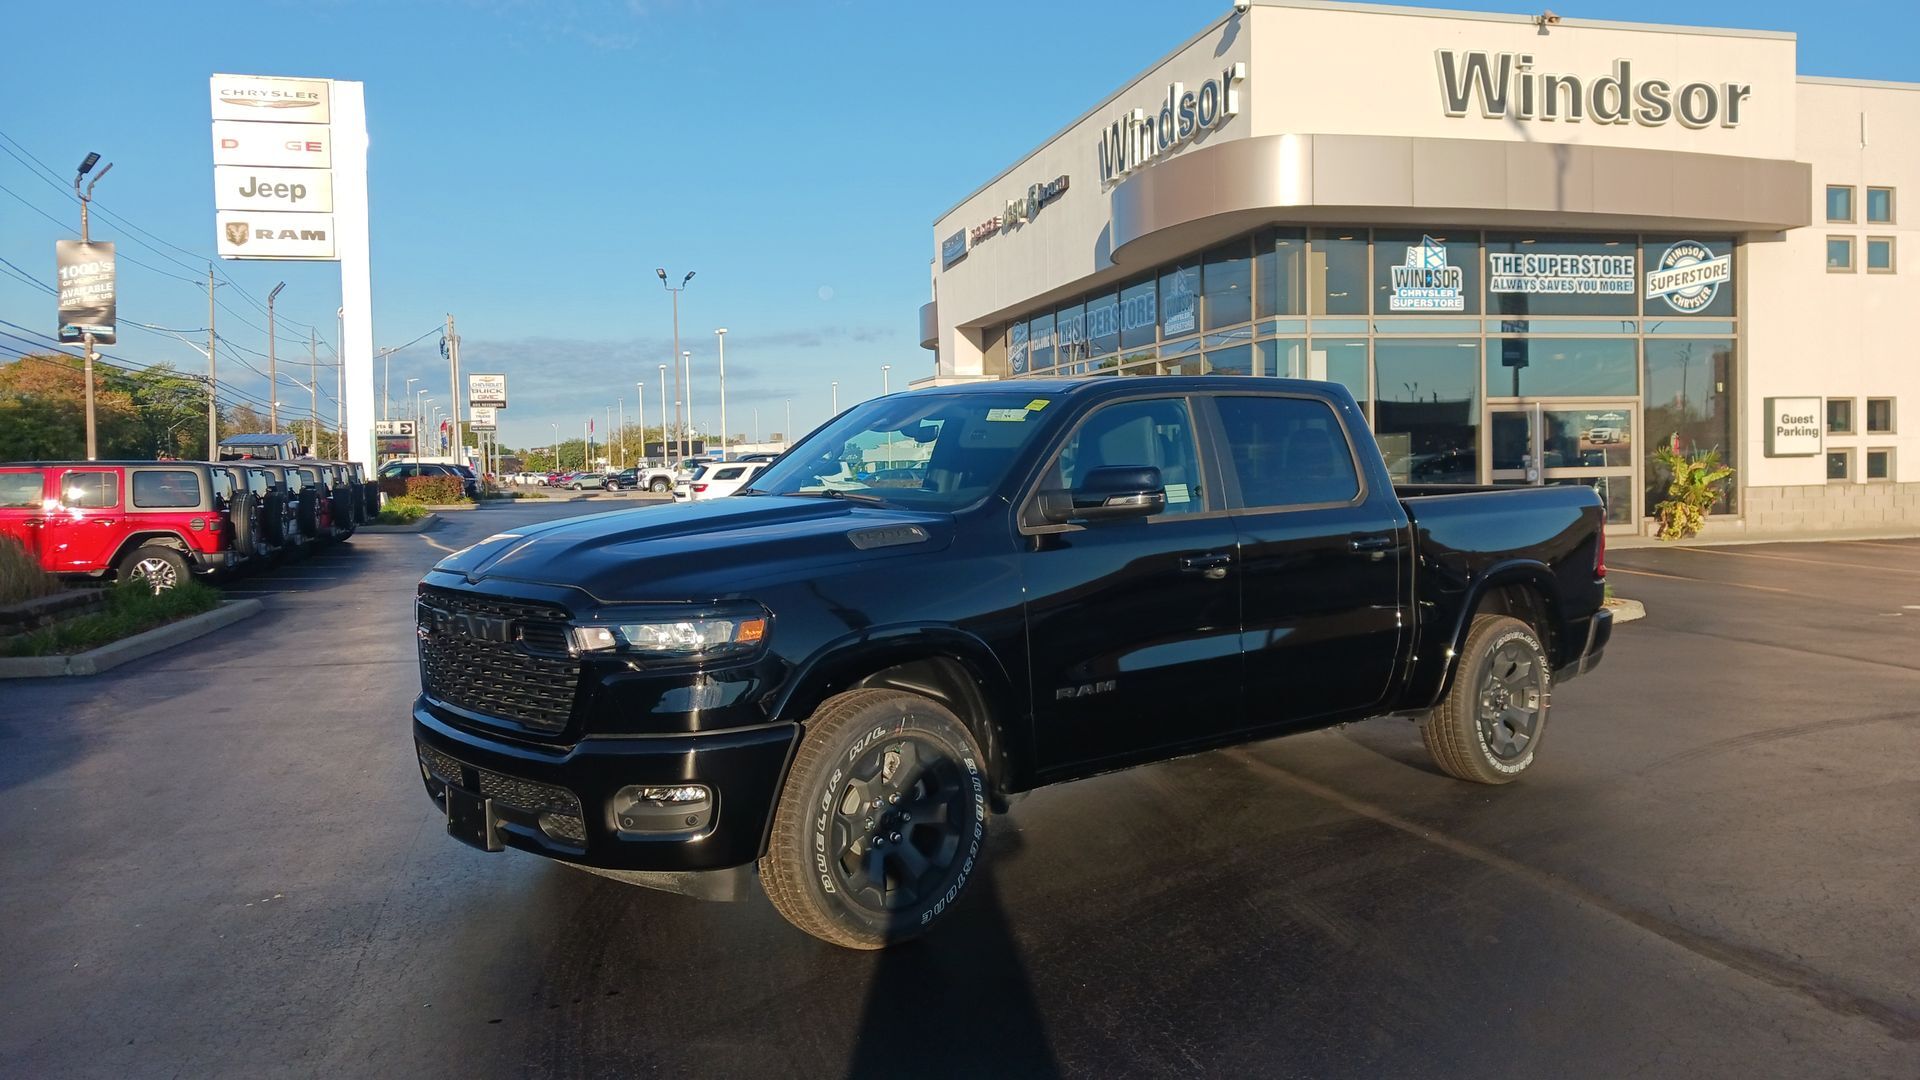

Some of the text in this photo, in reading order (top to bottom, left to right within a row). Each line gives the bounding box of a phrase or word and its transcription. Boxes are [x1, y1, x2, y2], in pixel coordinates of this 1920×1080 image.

[221, 89, 319, 100] CHRYSLER
[1434, 48, 1750, 129] Windsor
[1100, 62, 1246, 182] Windsor
[221, 138, 322, 153] DGE
[239, 176, 307, 203] Jeep
[255, 229, 326, 241] RAM
[1493, 255, 1633, 276] THE SUPERSTORE
[1665, 246, 1705, 266] WINDSOR
[1394, 268, 1460, 289] WINDSOR
[1492, 279, 1633, 292] ALWAYS SAVES YOU MORE!
[1650, 263, 1727, 292] SUPERSTORE
[1393, 298, 1461, 307] SUPERSTORE
[1673, 286, 1713, 308] CHRYSLER
[1073, 292, 1155, 343] SUPERSTORE
[1781, 413, 1814, 424] Guest
[1776, 426, 1819, 438] Parking
[433, 607, 510, 642] RAM
[1056, 680, 1116, 700] RAM
[814, 767, 842, 894] DUELER
[920, 757, 985, 925] BRIDGESTONE
